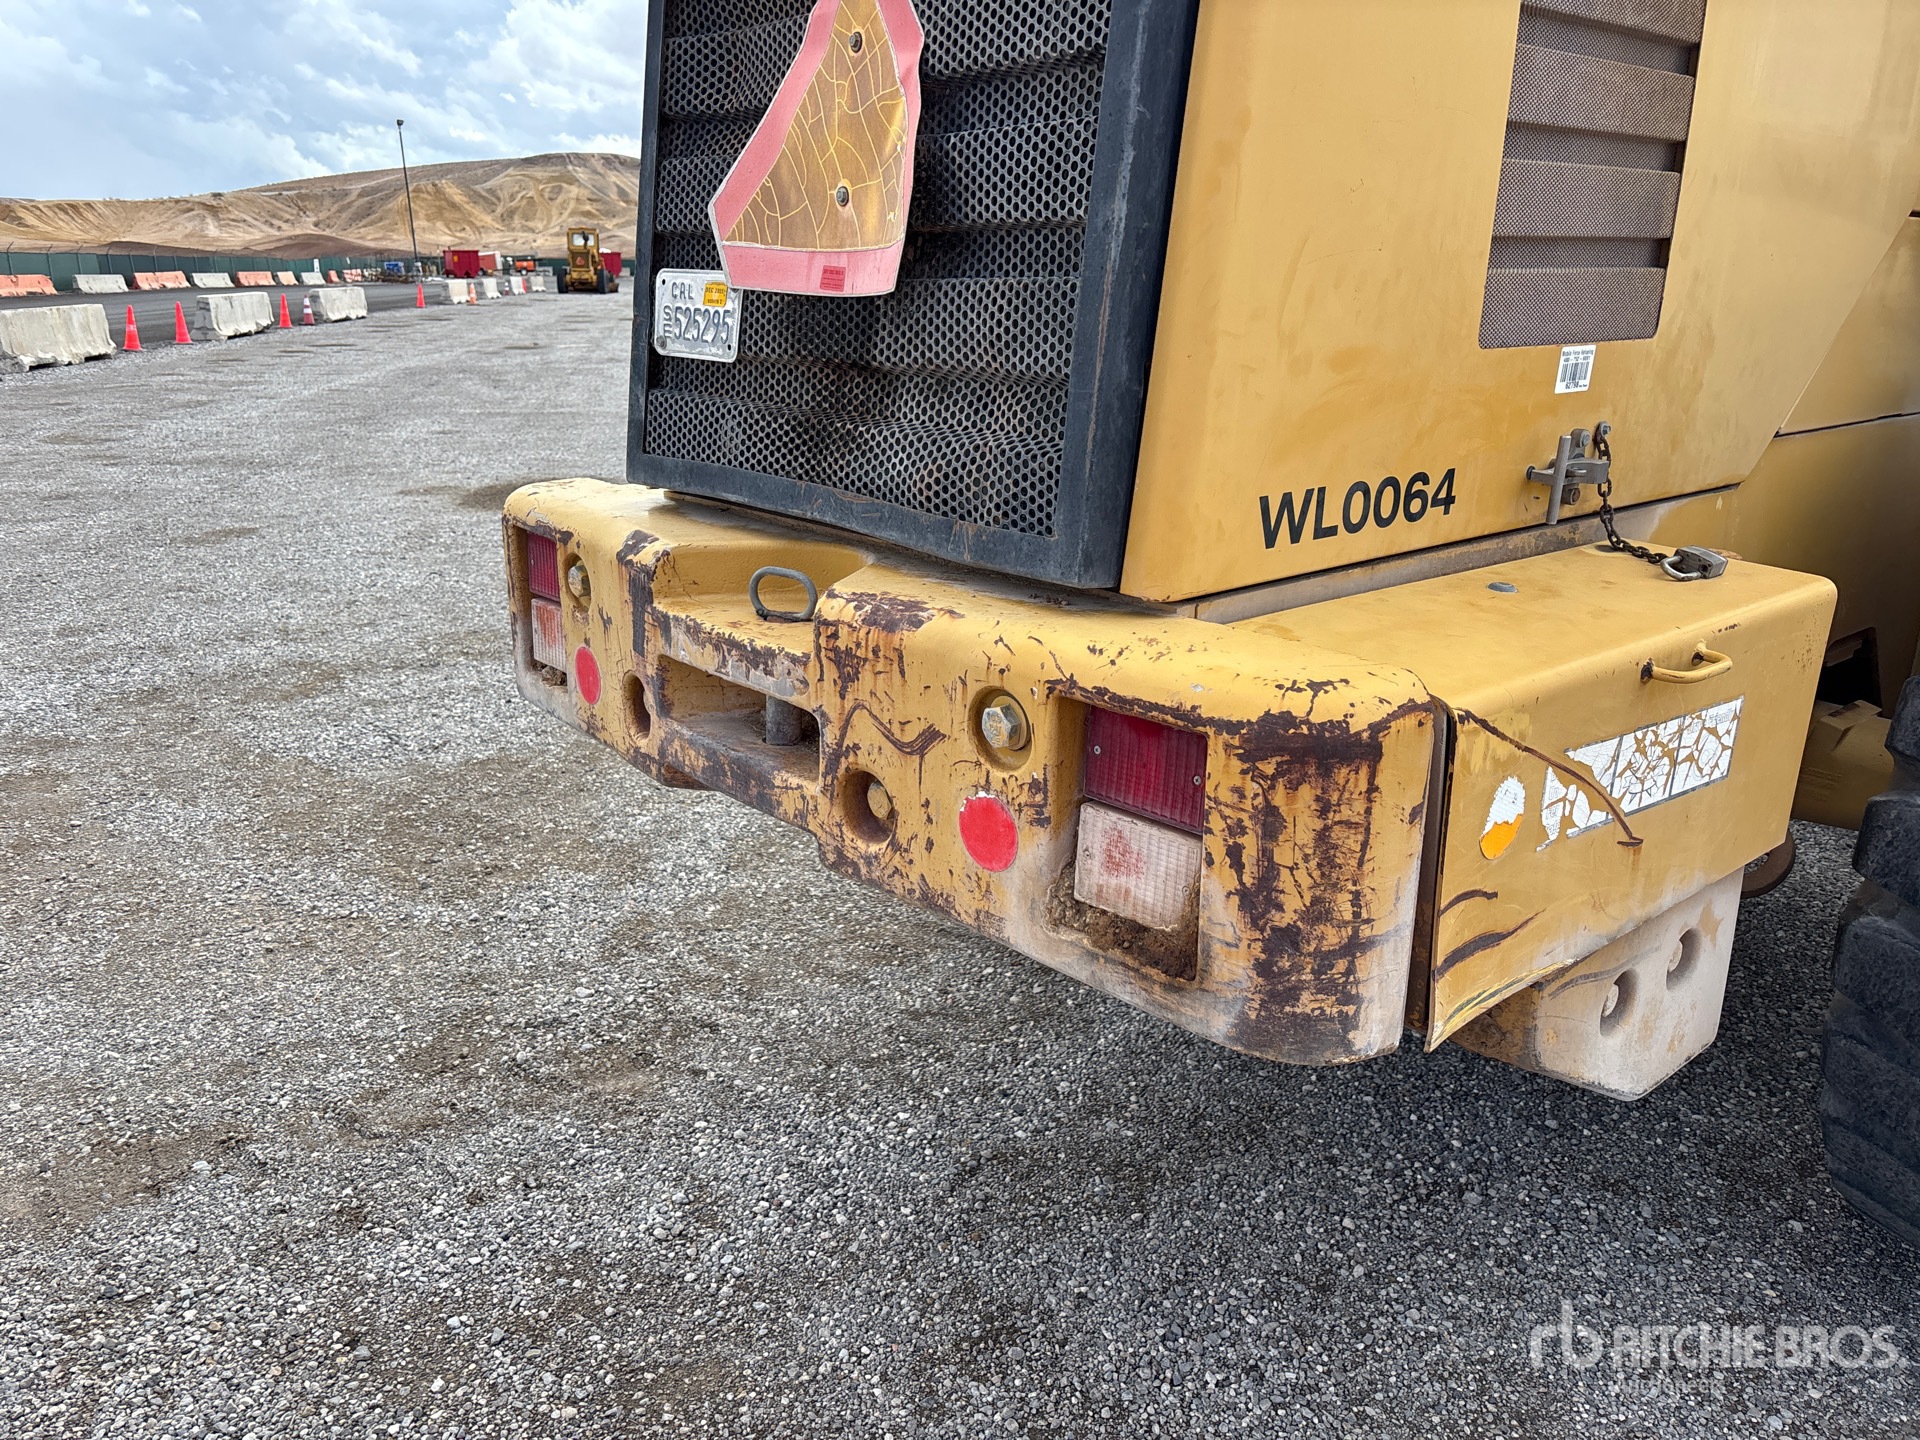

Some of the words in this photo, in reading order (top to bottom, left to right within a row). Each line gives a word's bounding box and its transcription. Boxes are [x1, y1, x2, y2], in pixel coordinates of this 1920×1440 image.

[671, 281, 694, 300] CAL
[674, 305, 731, 344] 525295
[1259, 467, 1456, 550] WL0064
